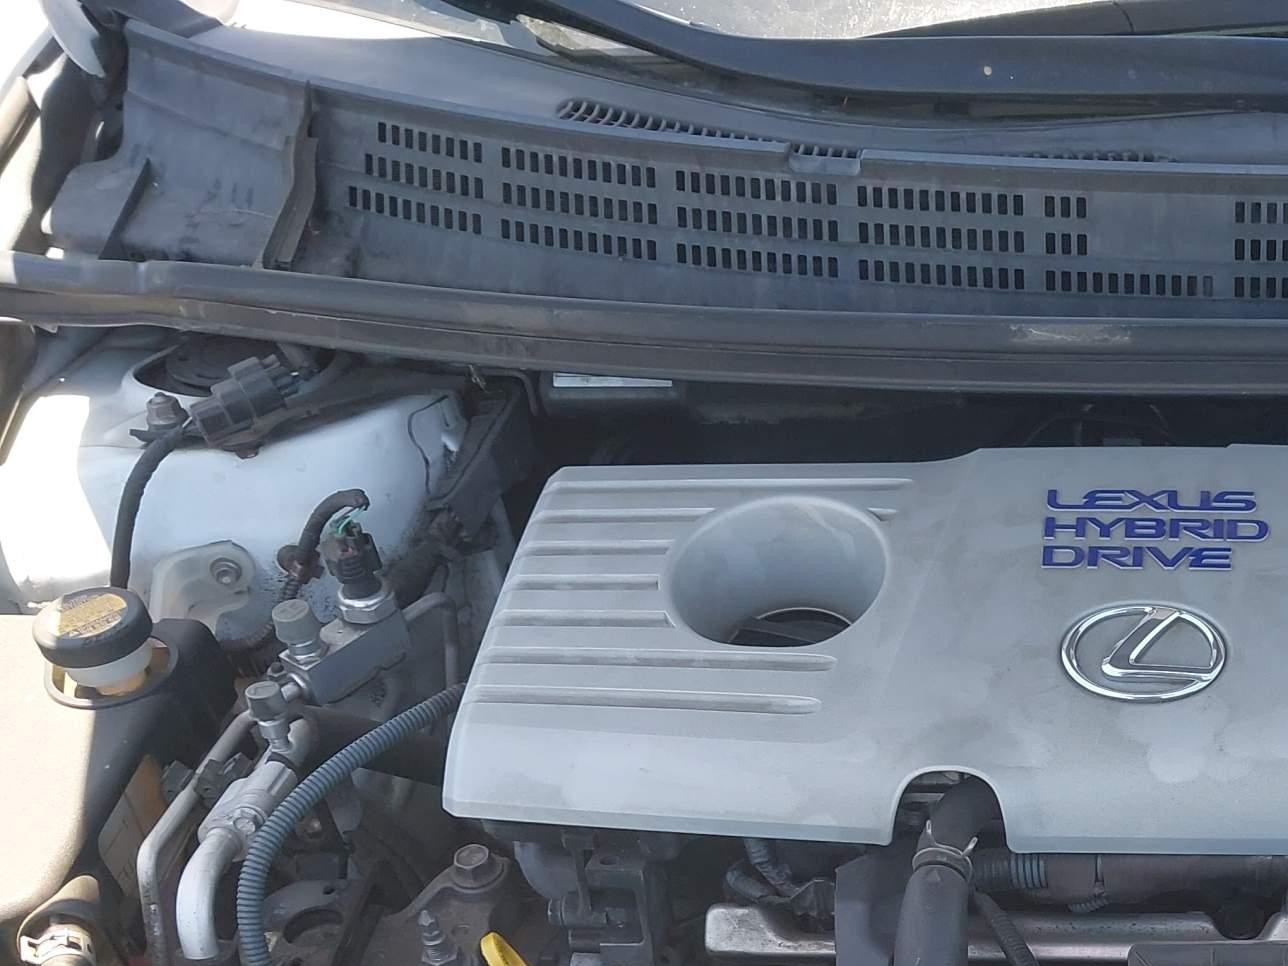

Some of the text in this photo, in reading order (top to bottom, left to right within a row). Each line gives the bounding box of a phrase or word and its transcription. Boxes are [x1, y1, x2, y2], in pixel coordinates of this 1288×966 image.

[1046, 489, 1257, 513] LEXUS
[1043, 516, 1270, 542] HYBRID
[1041, 544, 1233, 570] DRIVE
